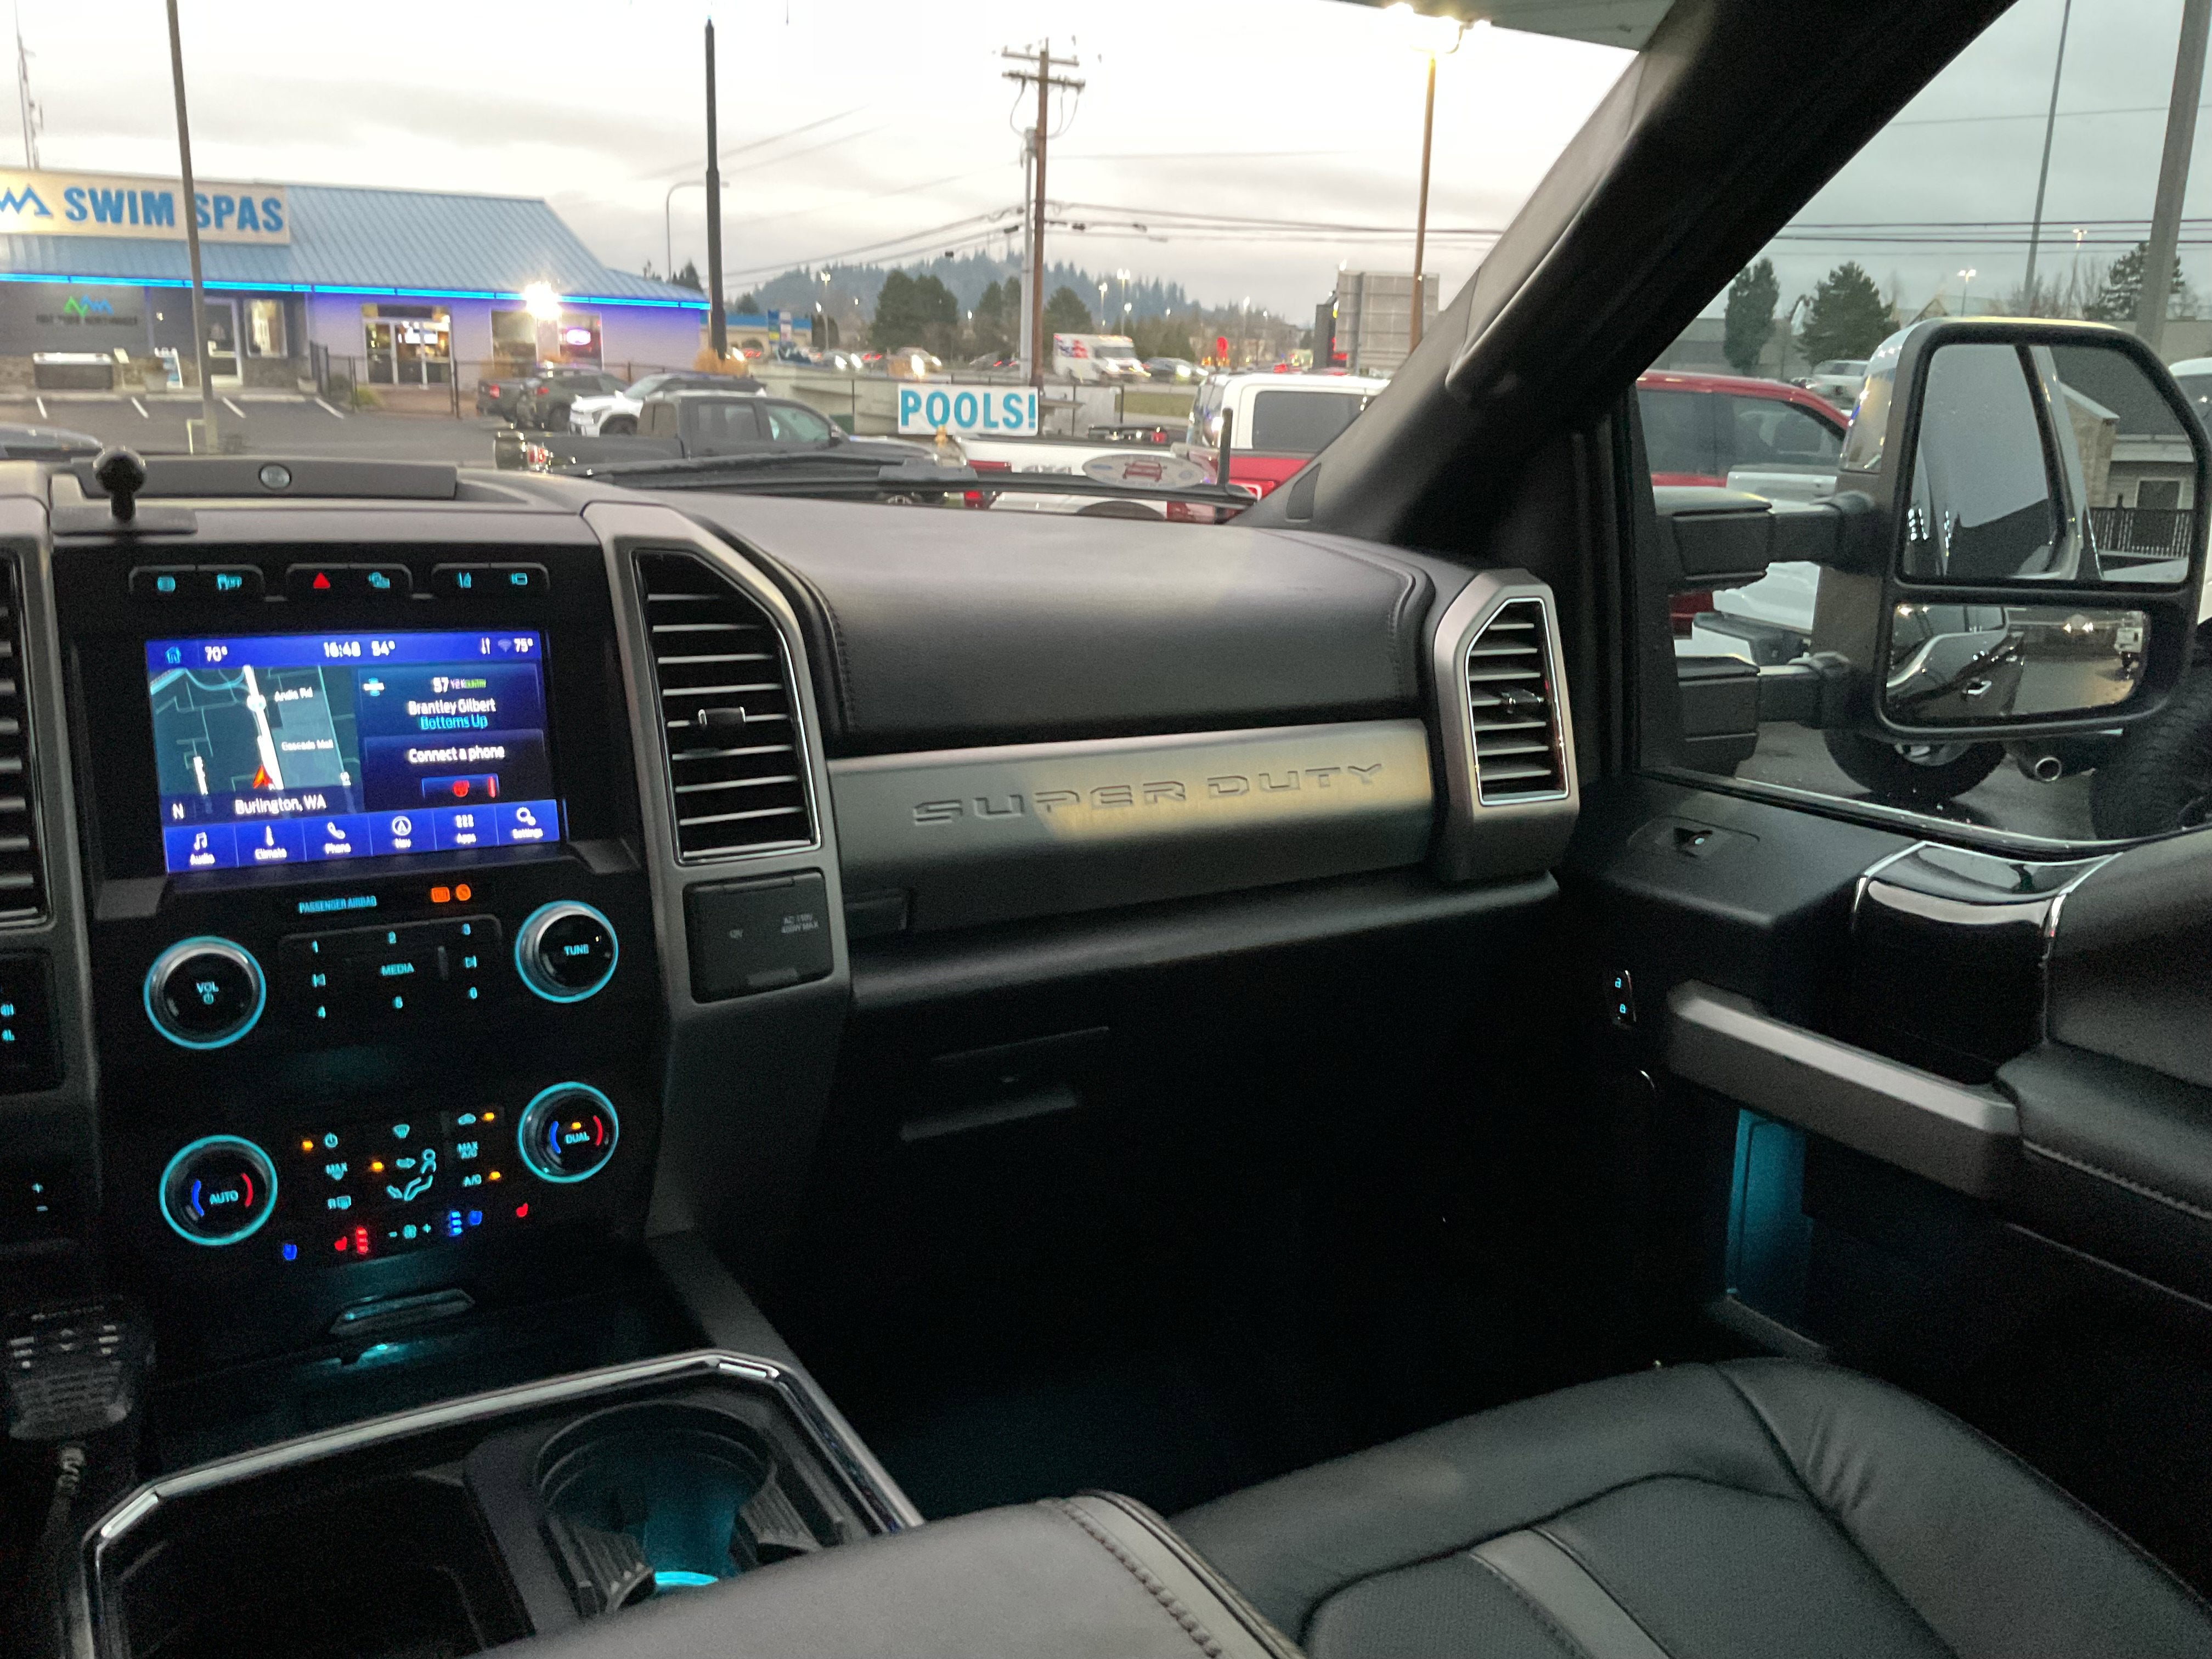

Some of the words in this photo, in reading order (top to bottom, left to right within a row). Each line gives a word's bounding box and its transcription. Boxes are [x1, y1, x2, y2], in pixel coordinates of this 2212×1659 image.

[64, 187, 175, 227] SWIM
[194, 193, 284, 232] SPAS
[900, 390, 1036, 429] POOLS!
[407, 700, 457, 716] Brantley
[458, 698, 496, 713] Gilbert
[420, 715, 470, 730] Bottoms
[471, 714, 489, 729] Up
[408, 747, 458, 764] Connect
[459, 748, 467, 761] a
[468, 744, 506, 763] phone
[912, 780, 1187, 826] SUPER
[1207, 763, 1383, 797] DUTY
[172, 803, 184, 820] N
[235, 798, 303, 815] Burlington,
[303, 794, 327, 811] WA
[564, 944, 589, 956] TUNE
[380, 962, 415, 977] MEDIA
[196, 981, 219, 994] VOL
[565, 1132, 590, 1144] DUAL
[209, 1190, 239, 1205] AUTO
